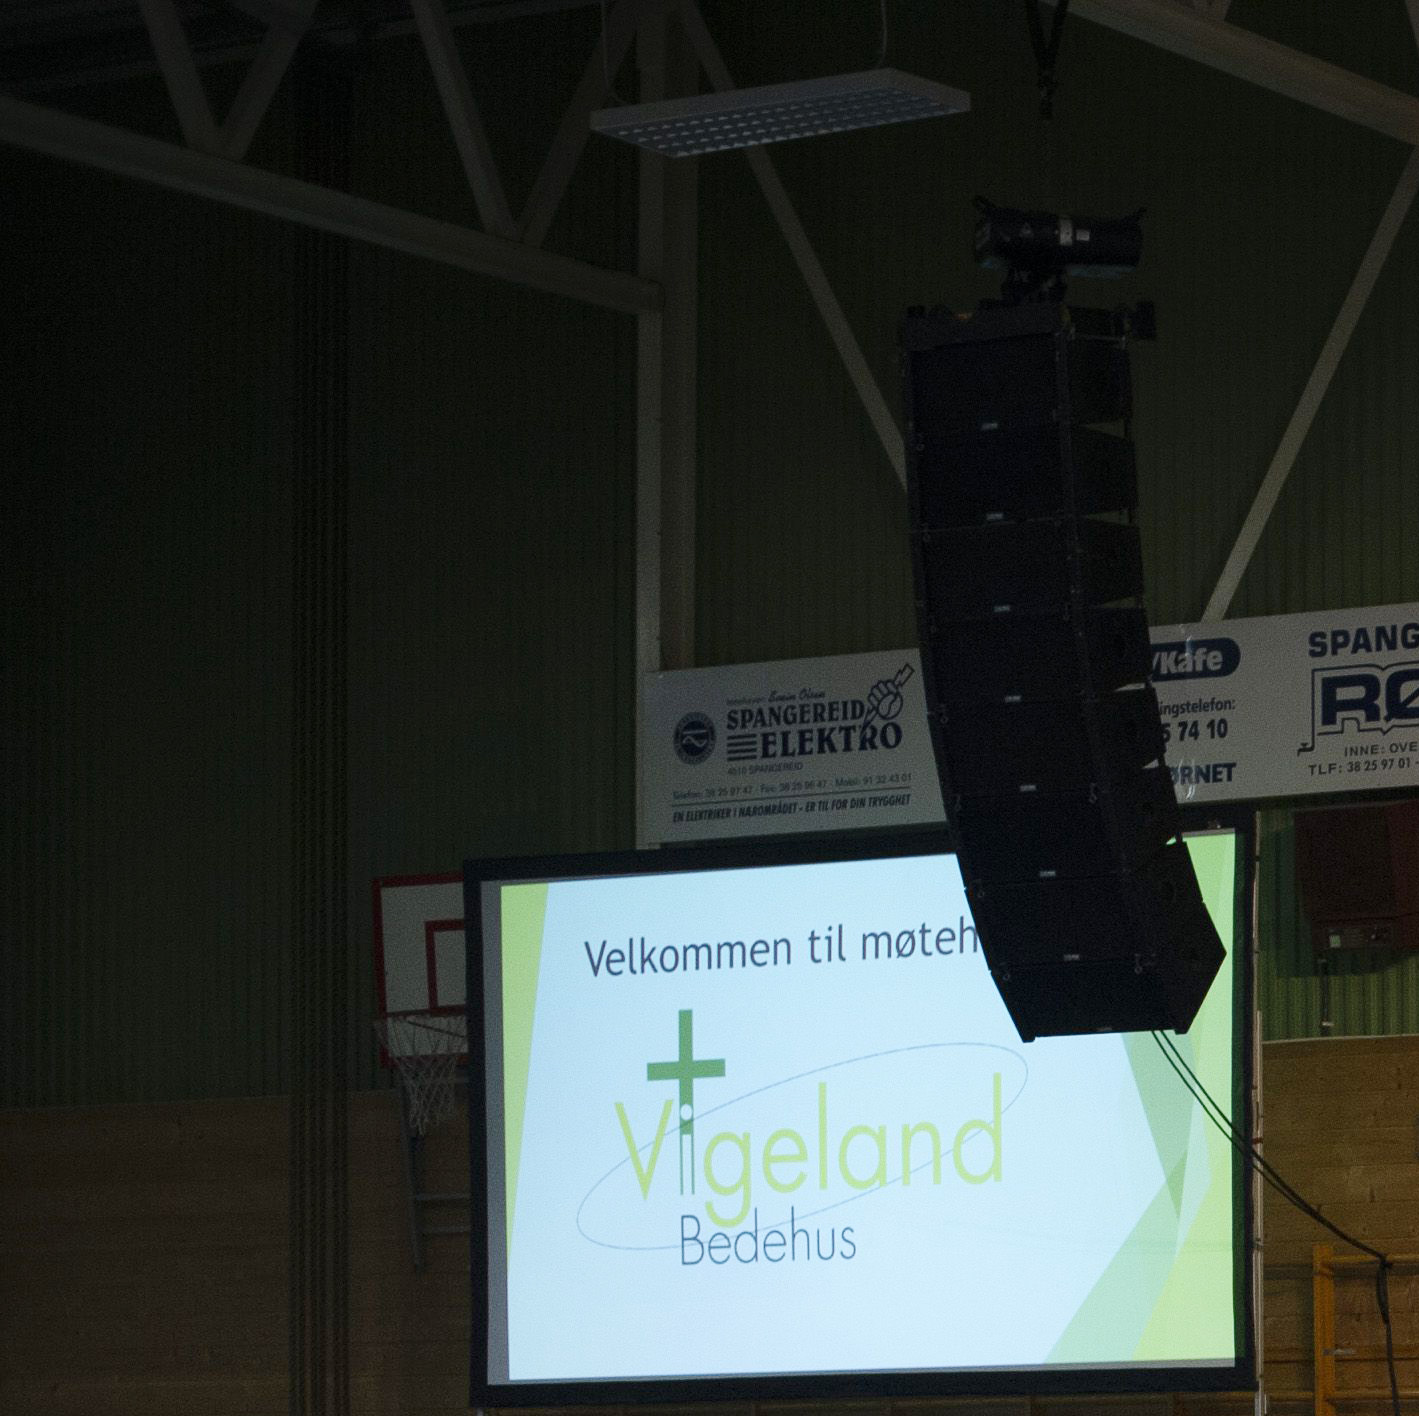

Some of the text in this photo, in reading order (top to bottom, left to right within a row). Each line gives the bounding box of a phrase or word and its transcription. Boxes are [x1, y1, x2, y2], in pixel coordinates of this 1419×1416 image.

[727, 699, 865, 730] SPANGEREID
[1178, 720, 1199, 741] 74
[1206, 718, 1228, 739] 10
[761, 722, 903, 760] ELEKTRO
[1344, 742, 1385, 757] INNE:
[1390, 740, 1417, 754] OVE
[749, 762, 803, 774] SPANGEREID
[1309, 762, 1343, 776] TLF:
[1347, 761, 1360, 773] 38
[1364, 760, 1377, 772] 25
[1381, 758, 1394, 770] 97
[1398, 757, 1411, 769] 01
[673, 812, 683, 823] EN
[686, 808, 731, 822] ELEKTRIKER
[850, 797, 865, 809] DIN
[868, 794, 912, 807] TRYGGHET
[584, 932, 792, 978] Velkommen
[808, 923, 847, 965] til
[614, 1072, 1003, 1229] Vigeland
[680, 1206, 857, 1267] Bedehus
